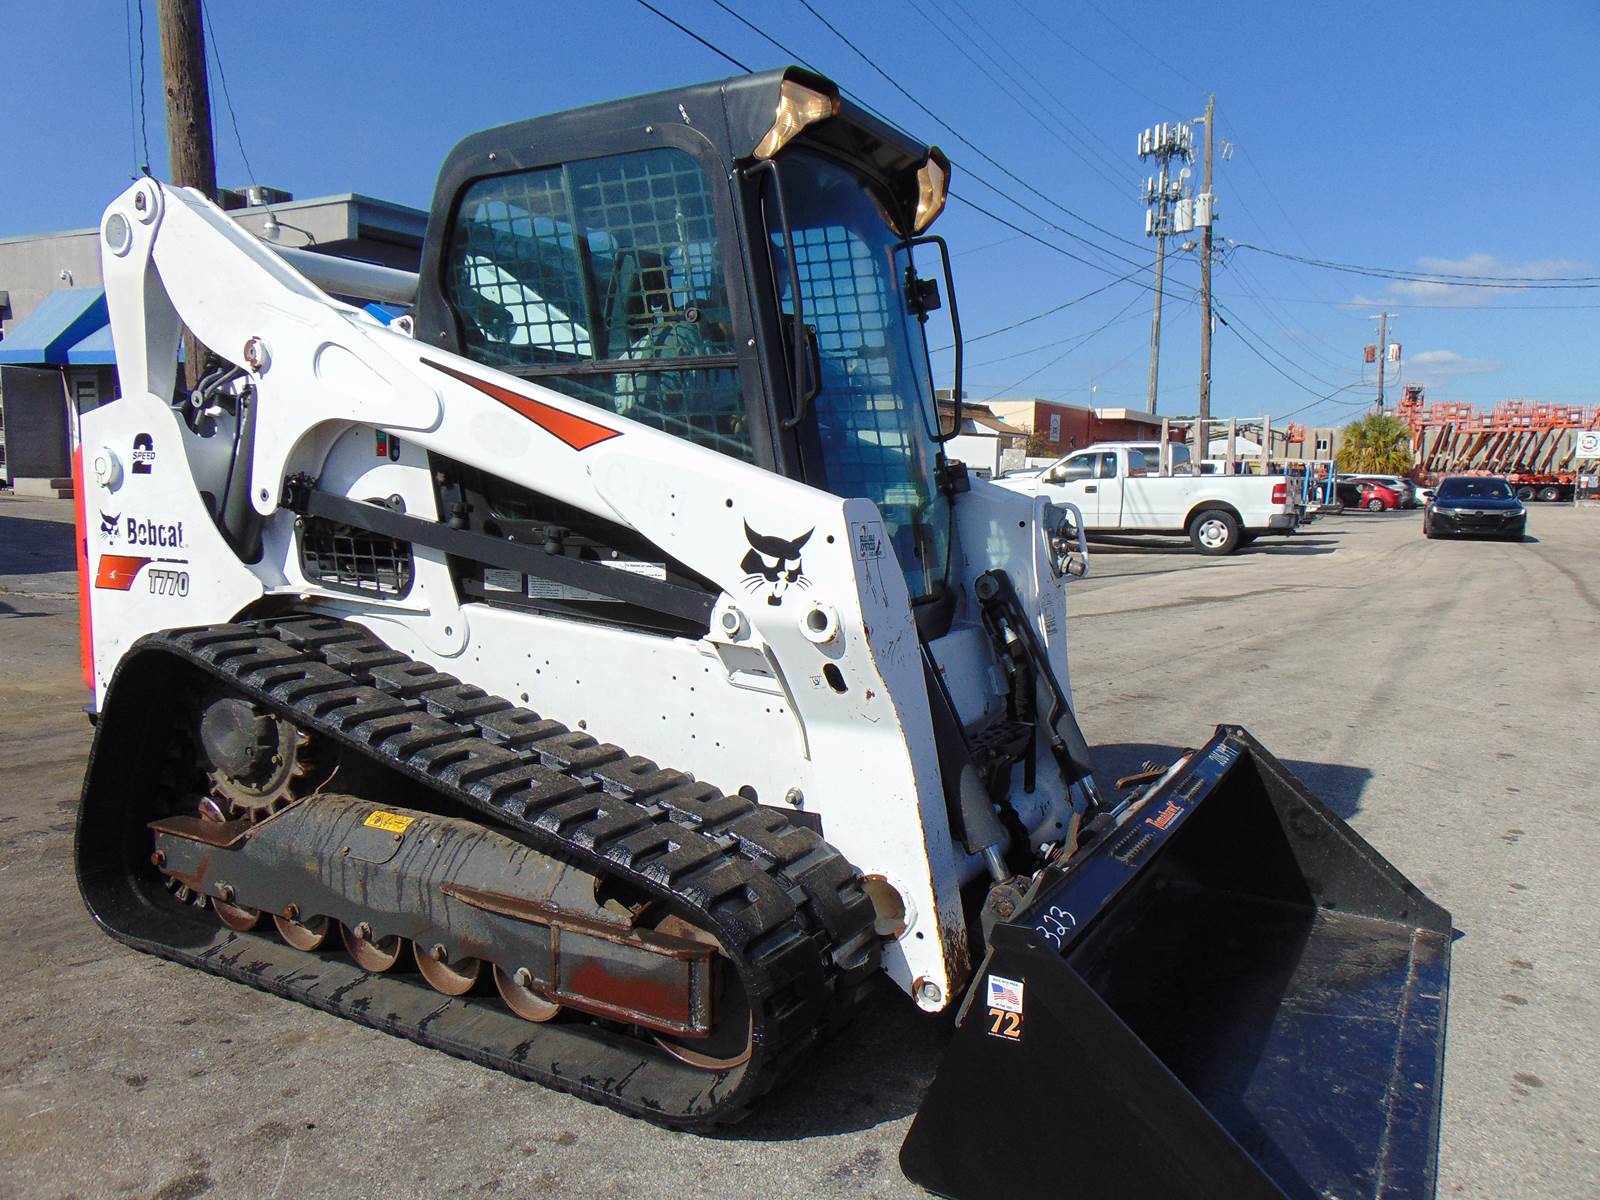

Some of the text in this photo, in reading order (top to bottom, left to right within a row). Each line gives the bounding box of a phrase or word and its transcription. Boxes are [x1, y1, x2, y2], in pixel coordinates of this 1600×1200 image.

[132, 433, 153, 474] 2
[132, 451, 156, 460] SPEED
[127, 517, 184, 549] Bobcat
[148, 568, 190, 597] T770
[1035, 905, 1077, 949] 323
